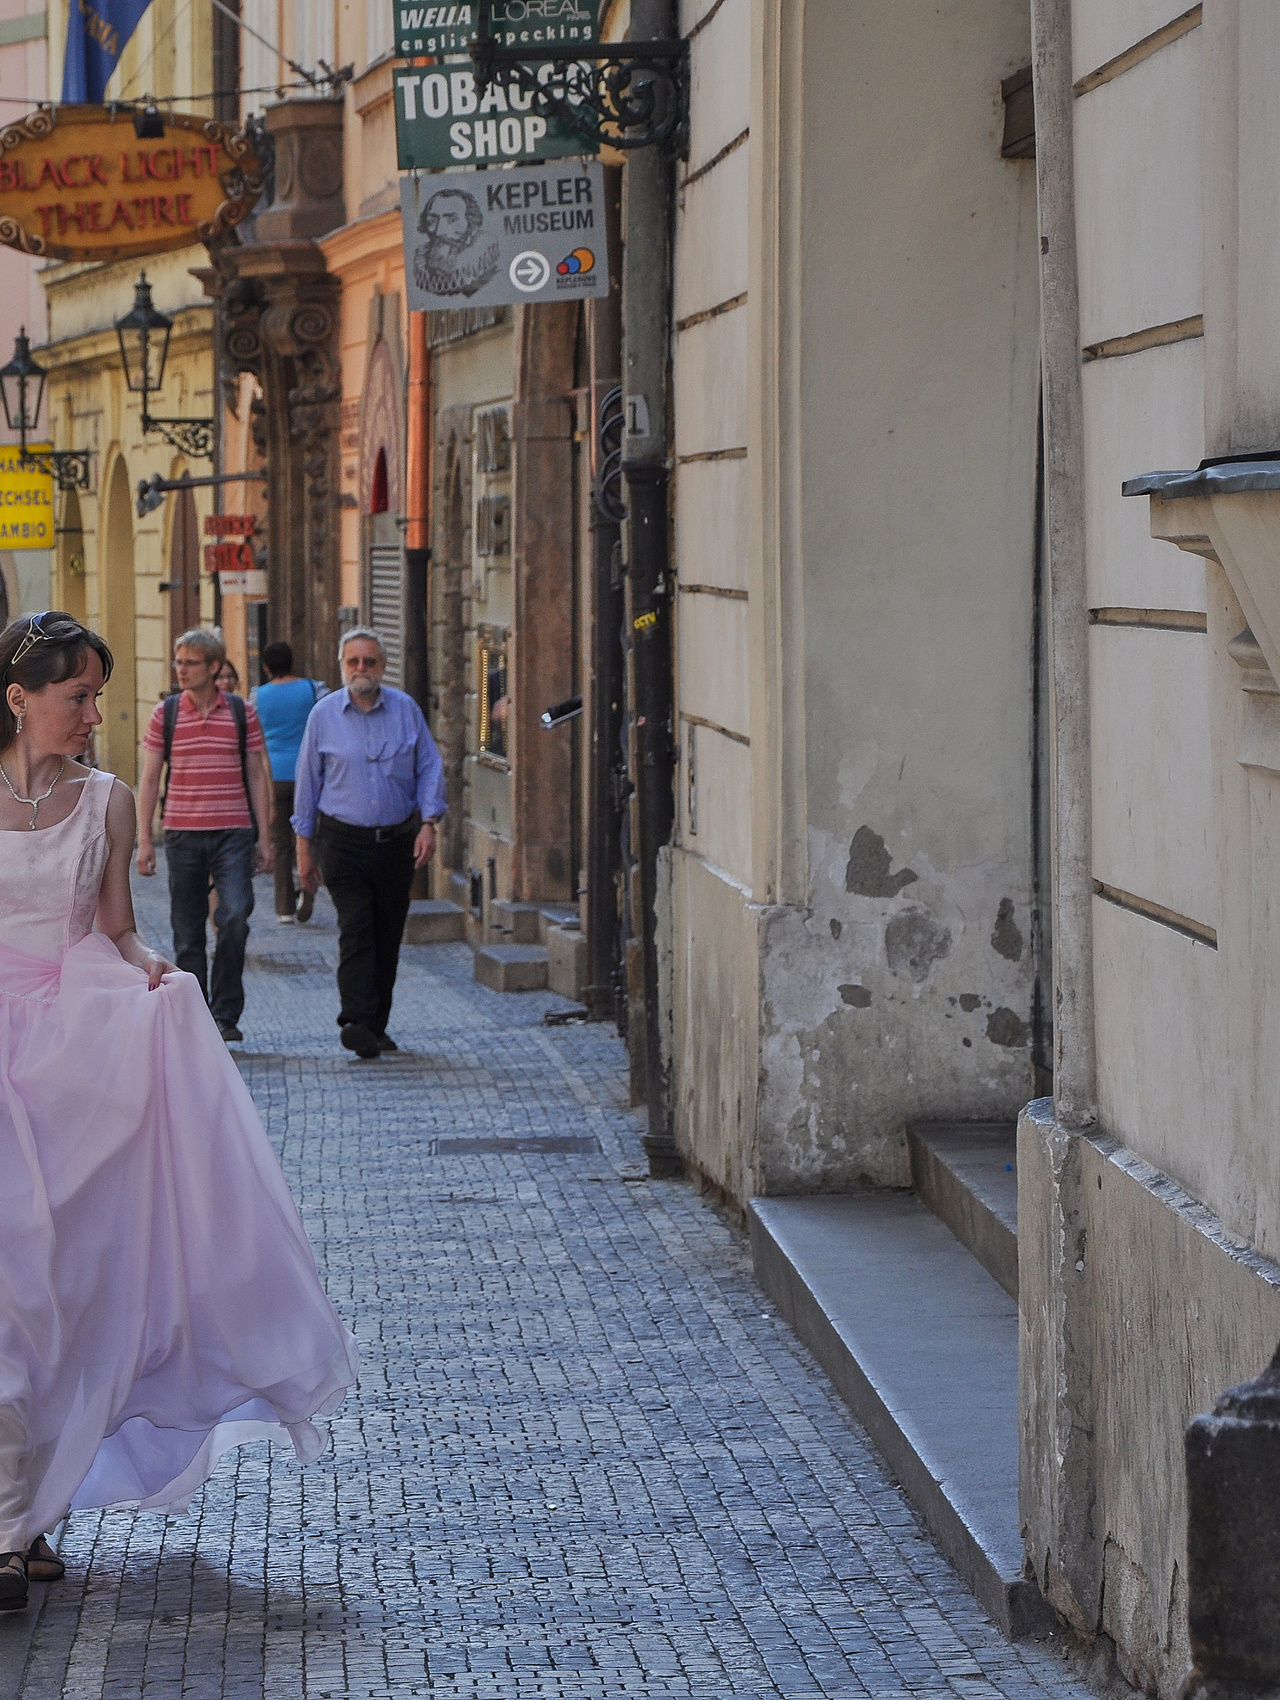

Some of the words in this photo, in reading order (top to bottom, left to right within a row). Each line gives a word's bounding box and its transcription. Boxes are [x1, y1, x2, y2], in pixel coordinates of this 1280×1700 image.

[397, 59, 594, 120] TOBACCO
[449, 115, 547, 160] SHOP
[122, 143, 221, 183] LIGHT
[35, 193, 197, 237] THEATRE
[486, 176, 593, 212] KEPLER
[503, 208, 595, 236] MUSEUM
